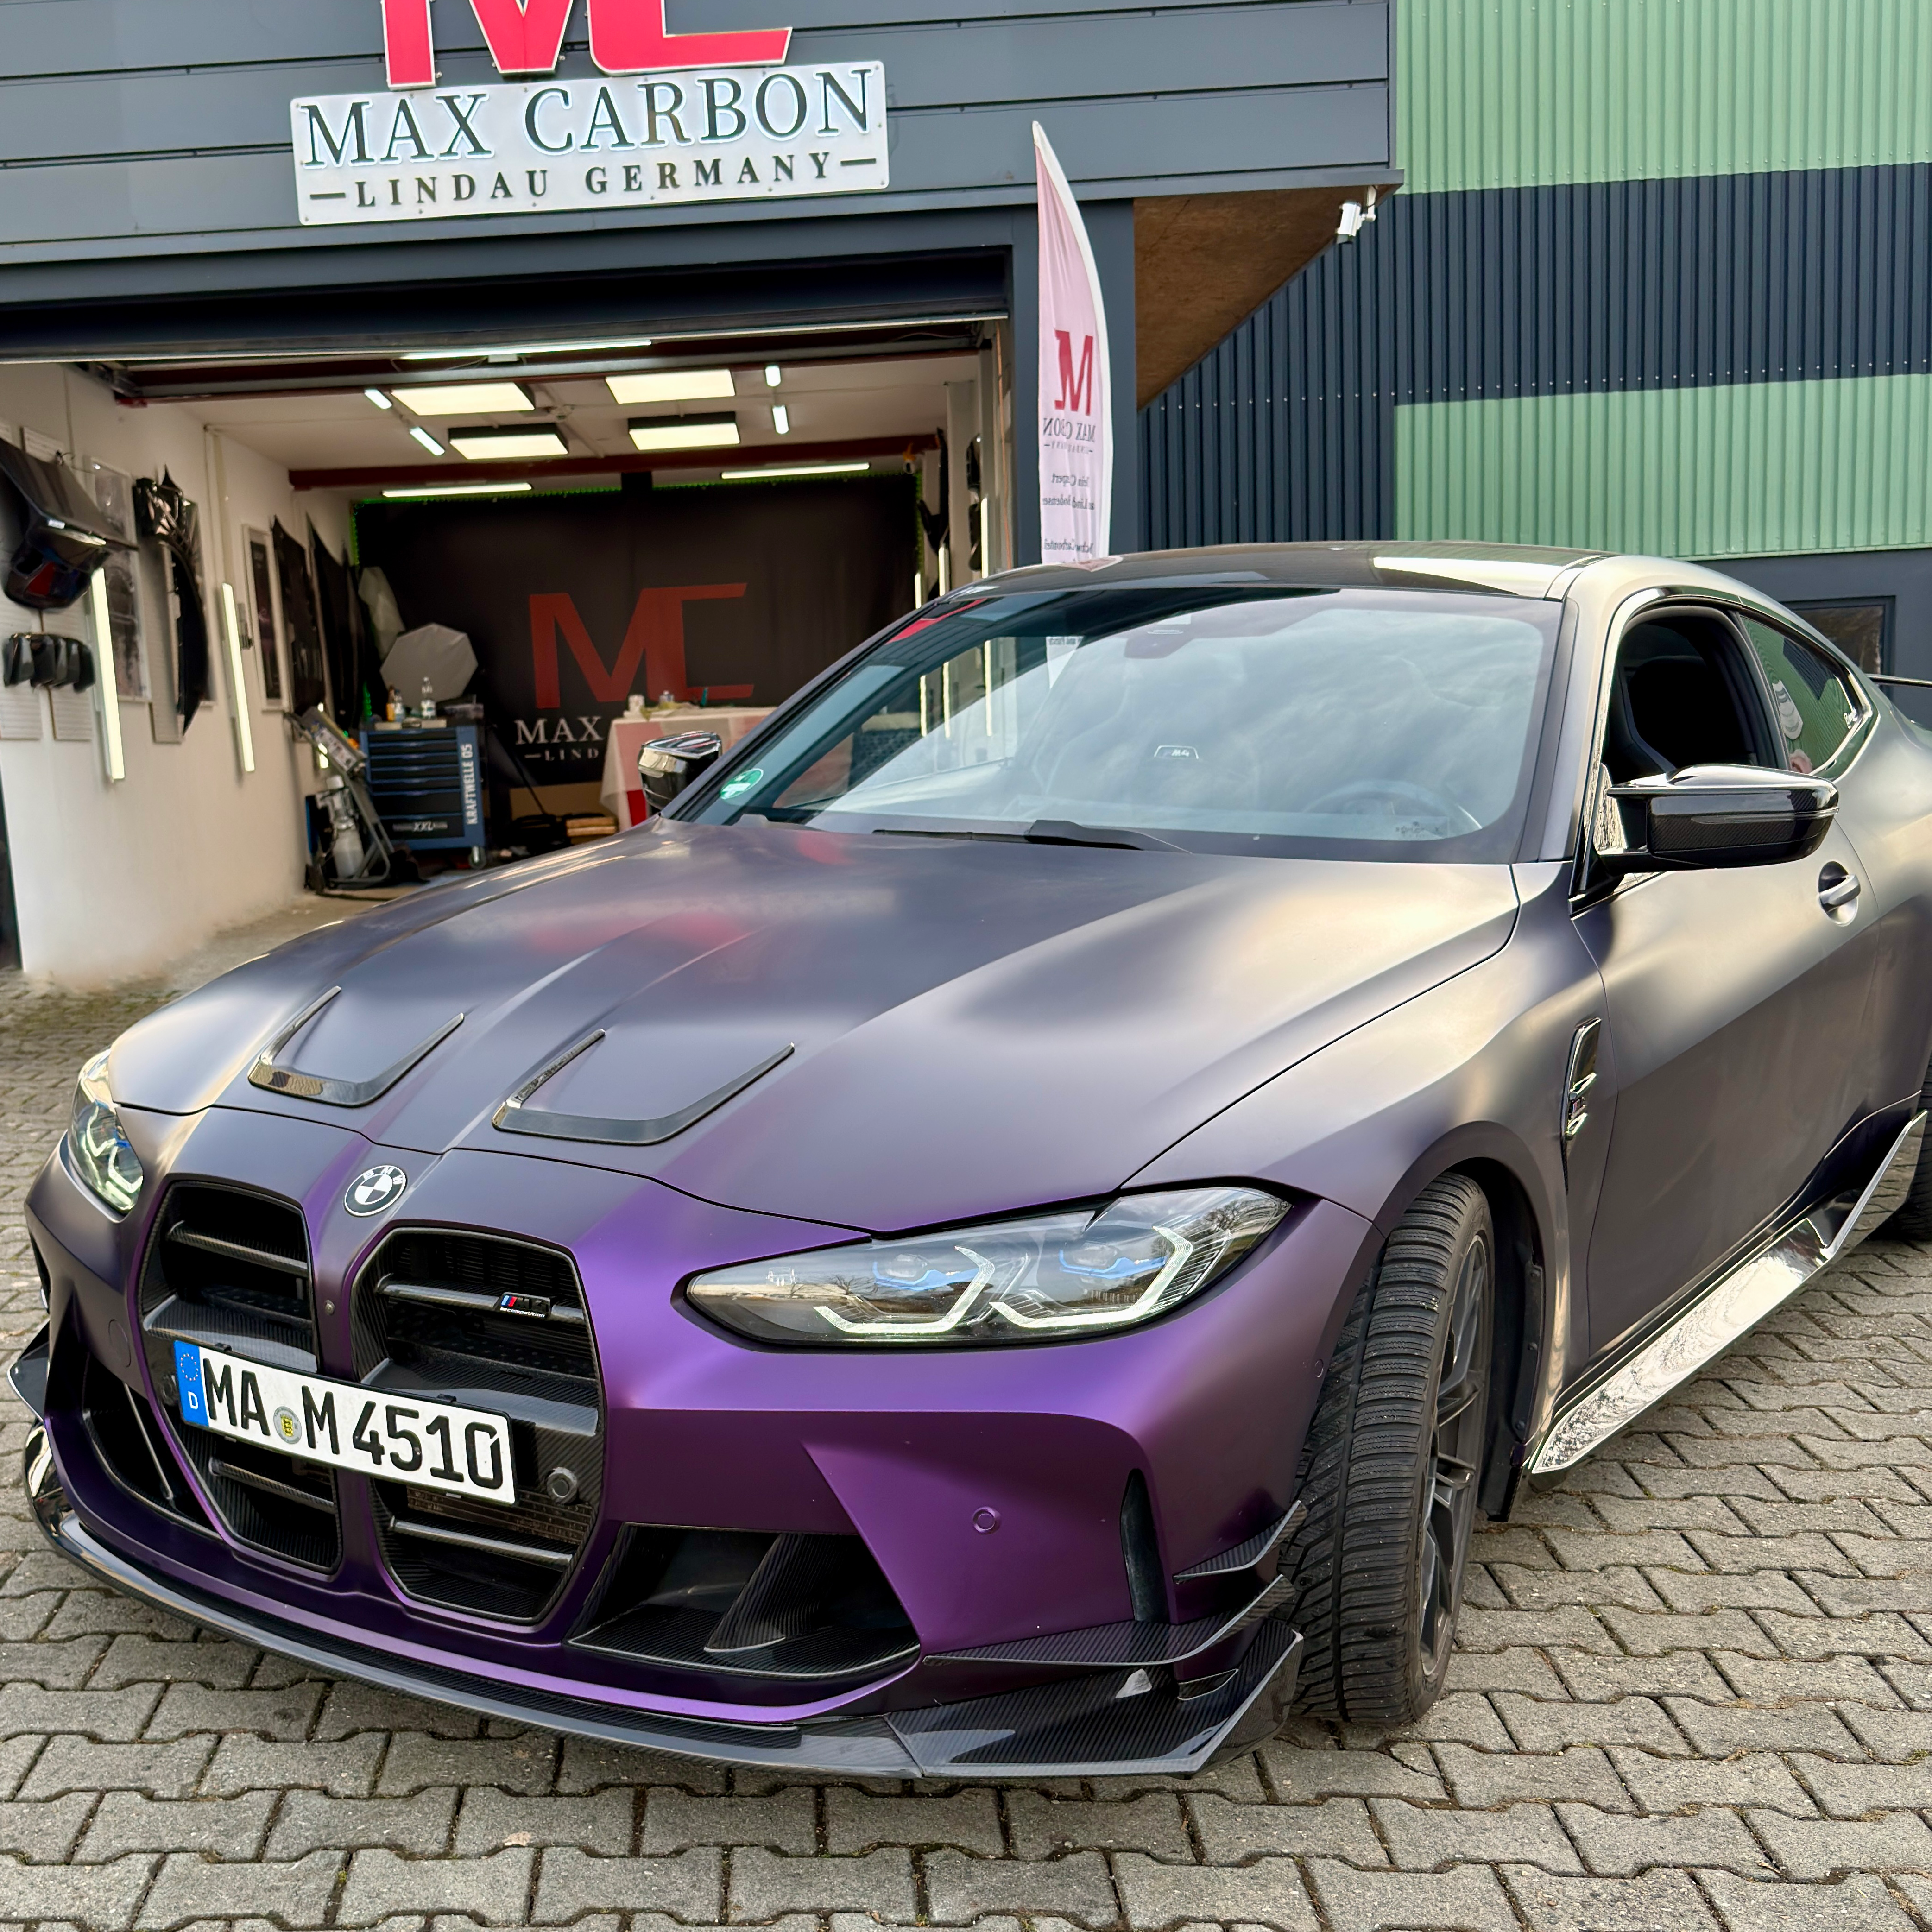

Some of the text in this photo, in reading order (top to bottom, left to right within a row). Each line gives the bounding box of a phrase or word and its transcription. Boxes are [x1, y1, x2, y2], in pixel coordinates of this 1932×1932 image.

[303, 68, 873, 167] MAX CARBON
[357, 151, 830, 208] LINDAU GERMANY
[529, 583, 754, 709] MC
[514, 716, 603, 745] MAX
[412, 821, 434, 833] XXL
[363, 1166, 403, 1185] BMW
[506, 1308, 545, 1318] competition
[188, 1390, 199, 1410] D
[203, 1357, 271, 1436] MA
[302, 1385, 340, 1455] M
[353, 1400, 504, 1490] 4510
